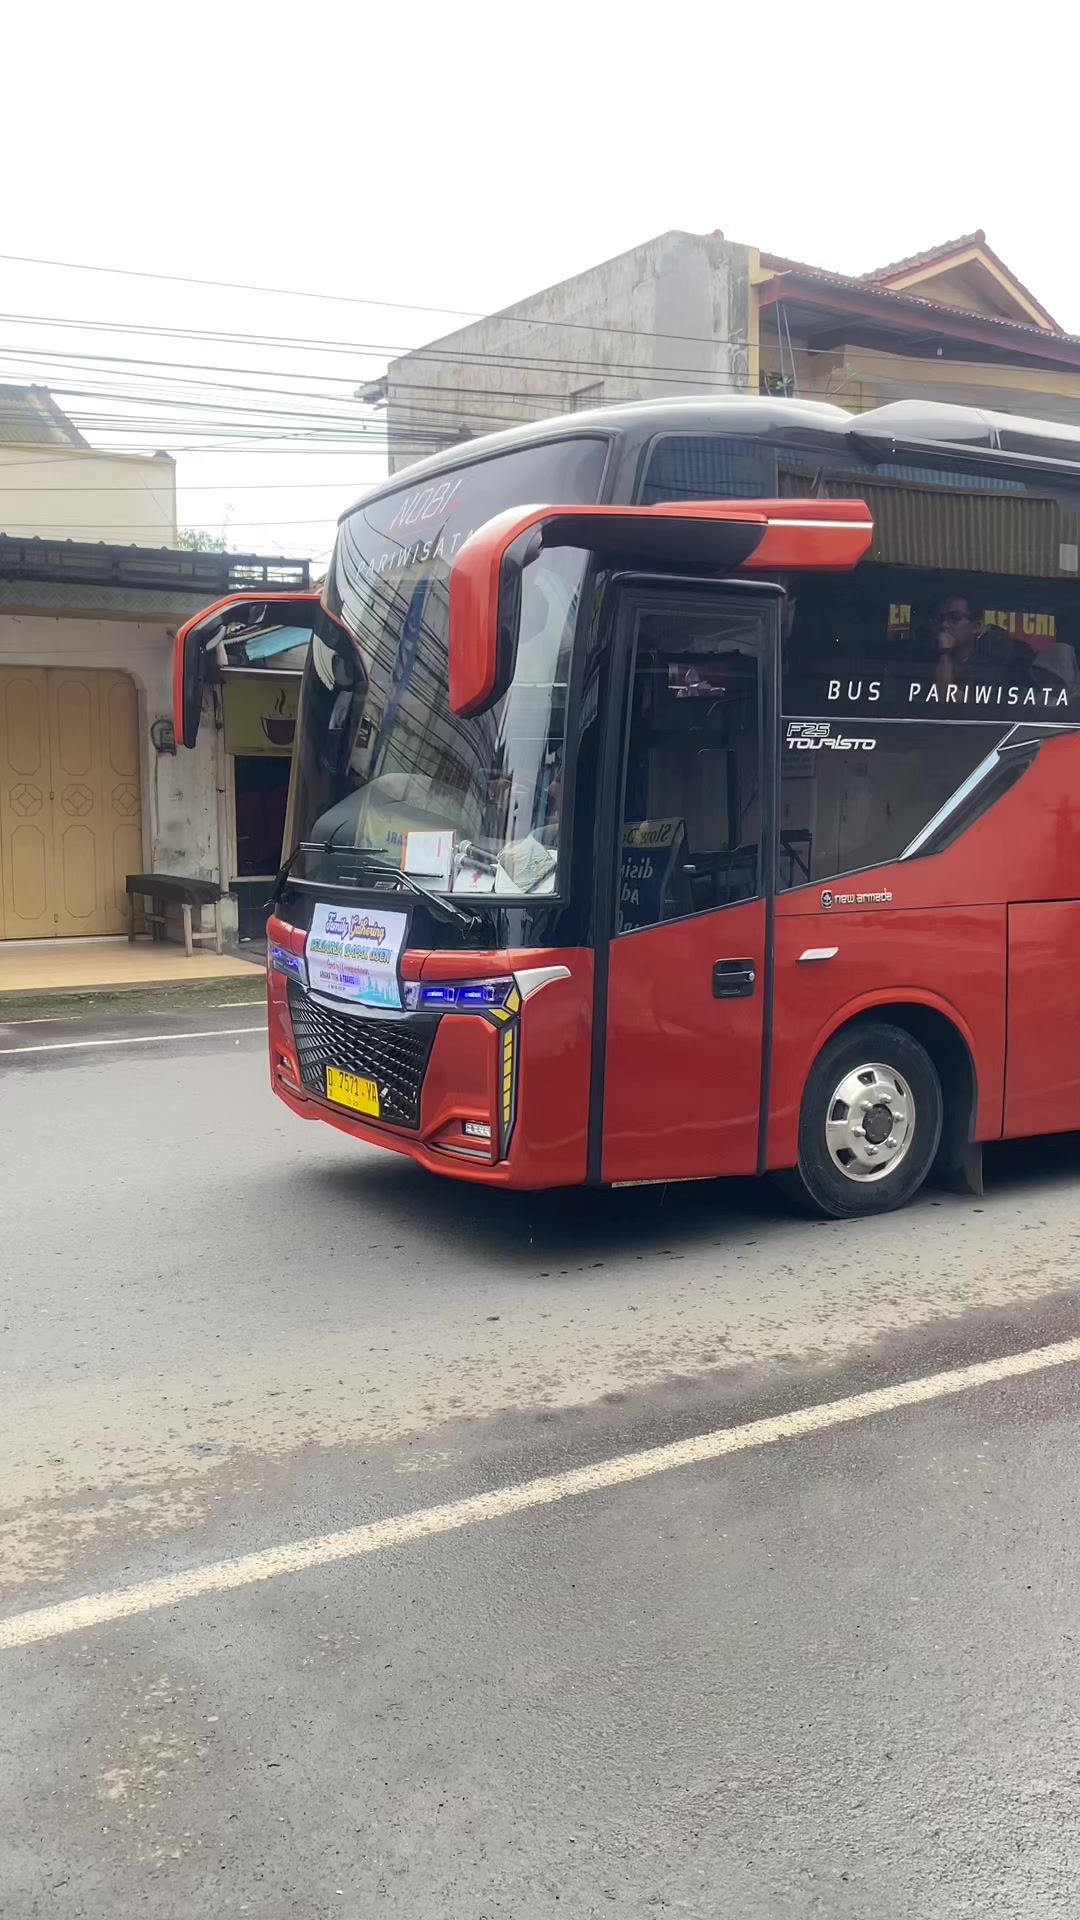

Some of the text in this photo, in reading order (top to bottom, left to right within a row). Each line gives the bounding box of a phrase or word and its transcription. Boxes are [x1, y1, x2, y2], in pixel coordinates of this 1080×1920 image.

[389, 479, 464, 530] NOBI
[828, 680, 1069, 706] BUS PARIWISATA
[787, 722, 831, 737] F25
[834, 887, 893, 904] new armada
[326, 911, 386, 946] Family Gathering
[328, 1068, 333, 1086] D
